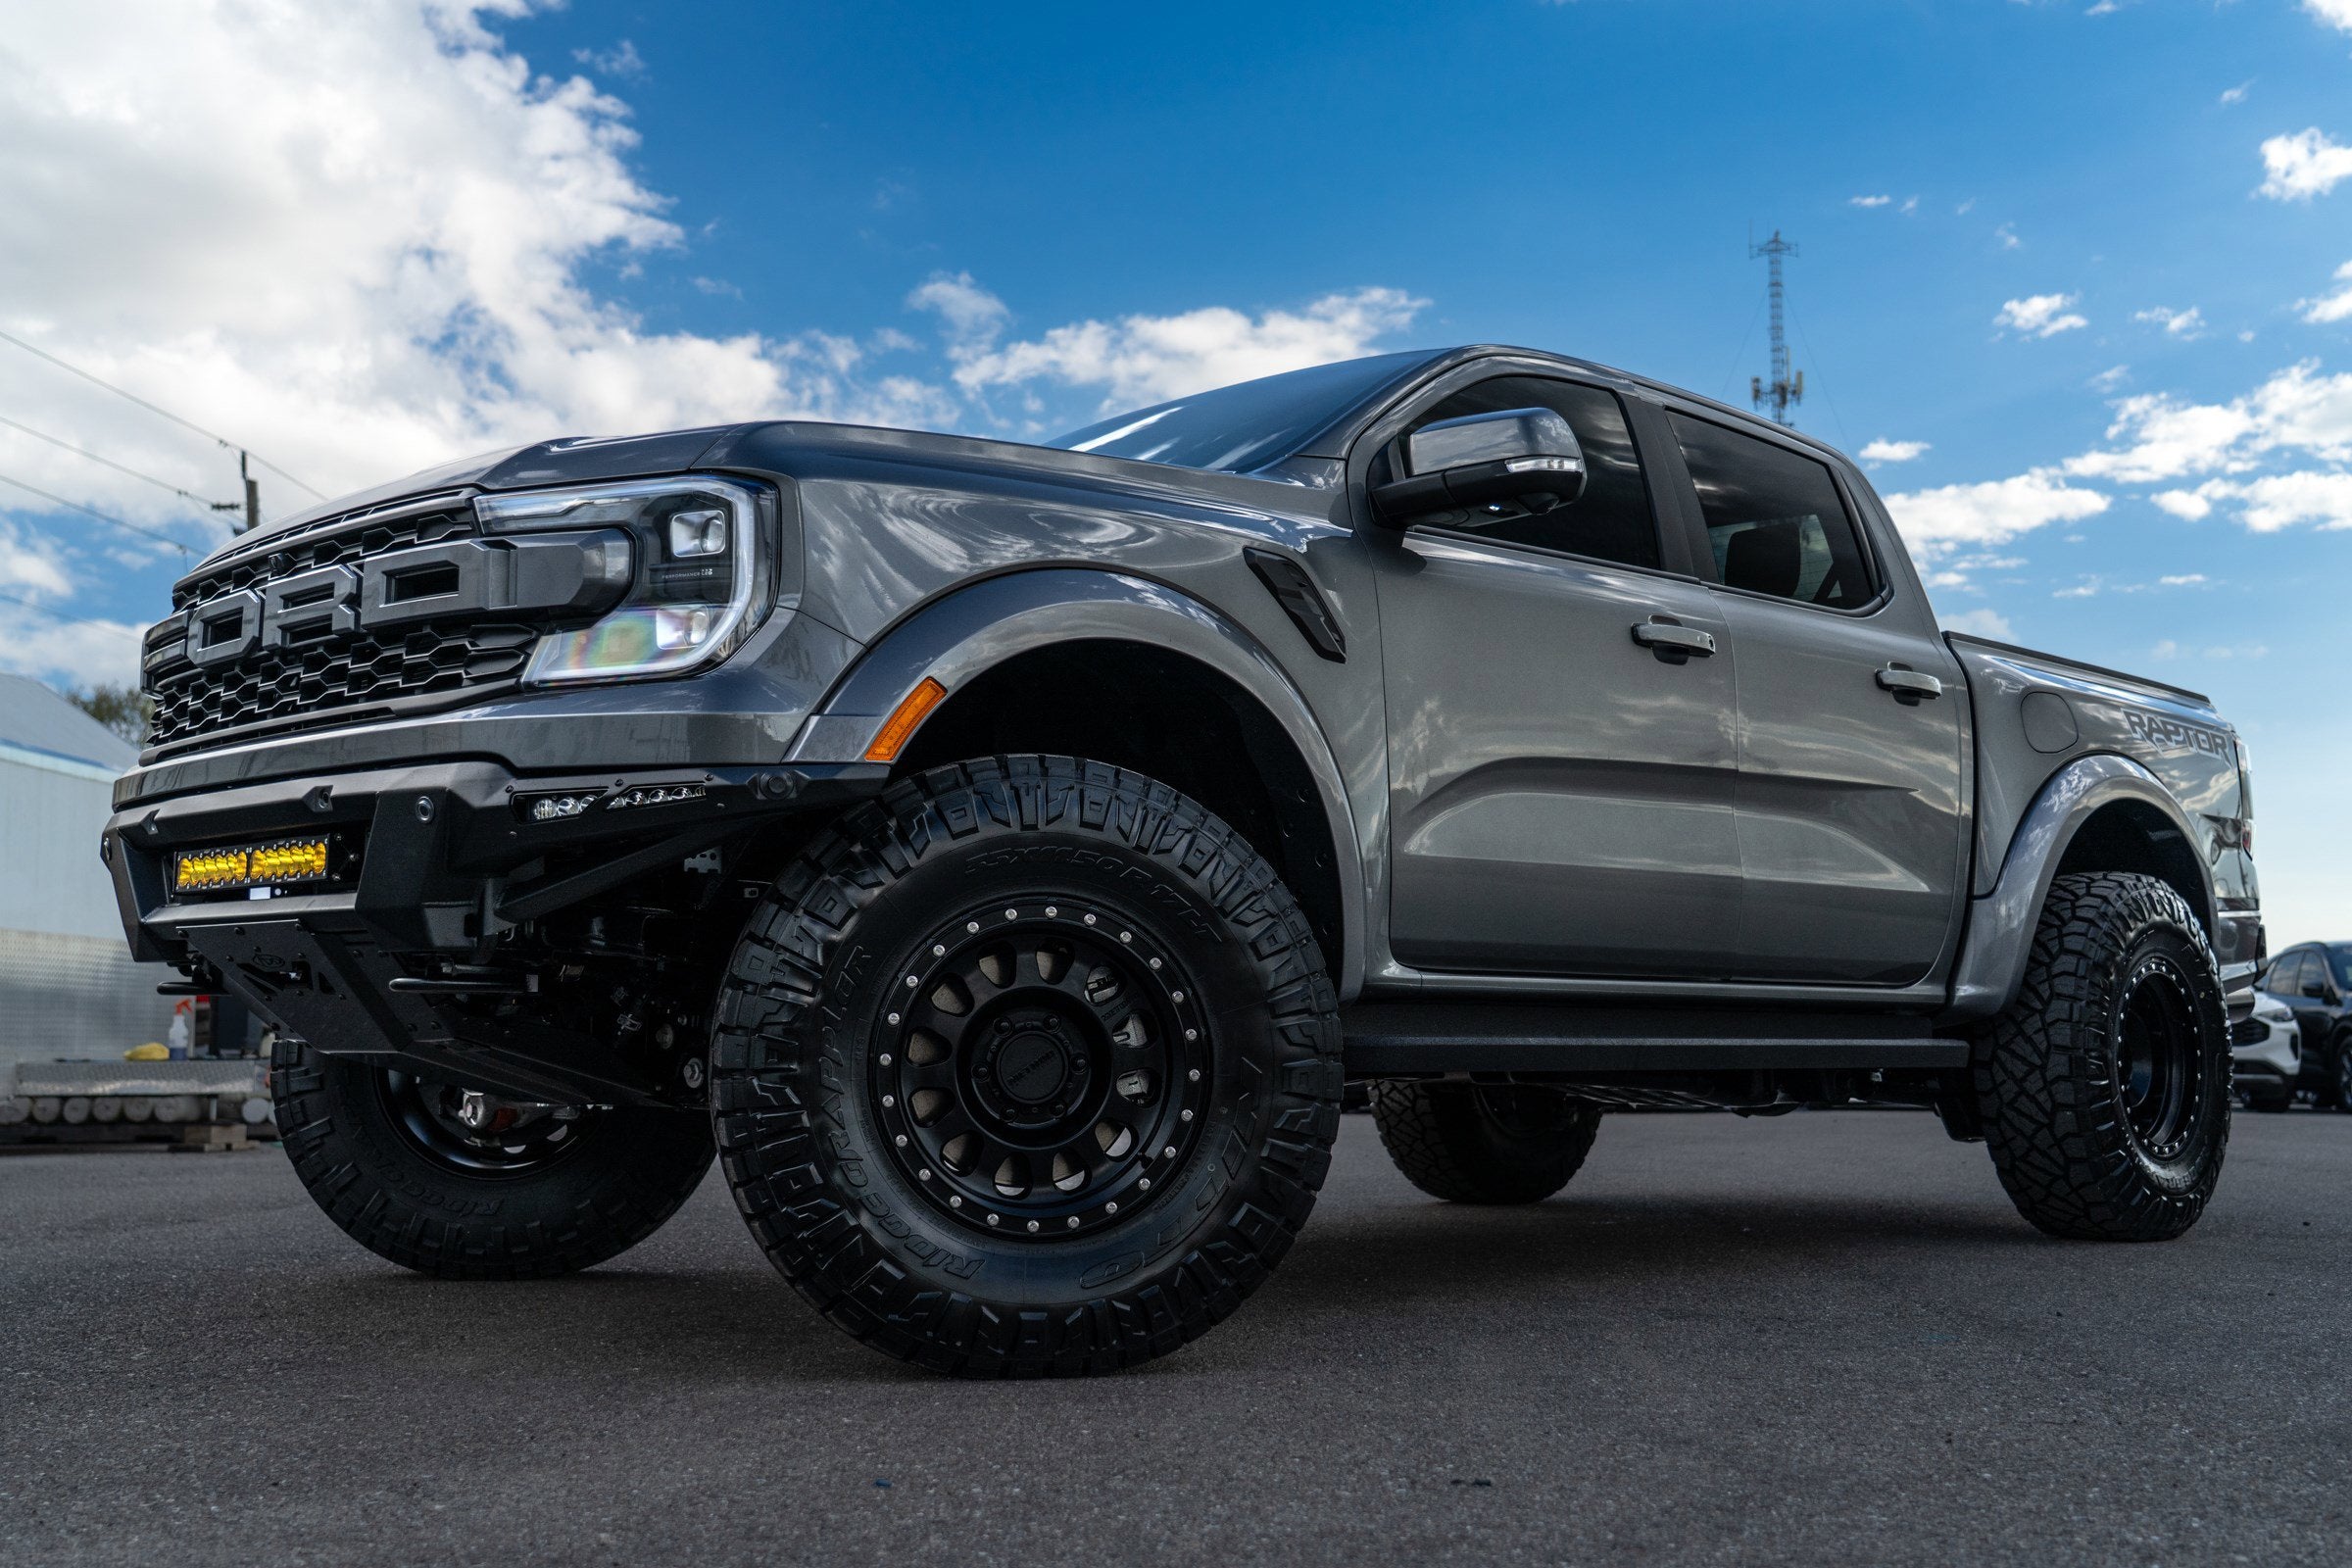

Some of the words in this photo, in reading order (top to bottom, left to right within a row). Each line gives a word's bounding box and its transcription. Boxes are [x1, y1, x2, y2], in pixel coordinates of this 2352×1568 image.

[142, 539, 491, 699] FORD
[2122, 709, 2233, 770] RAPTOR
[859, 1192, 986, 1280] RIDGE
